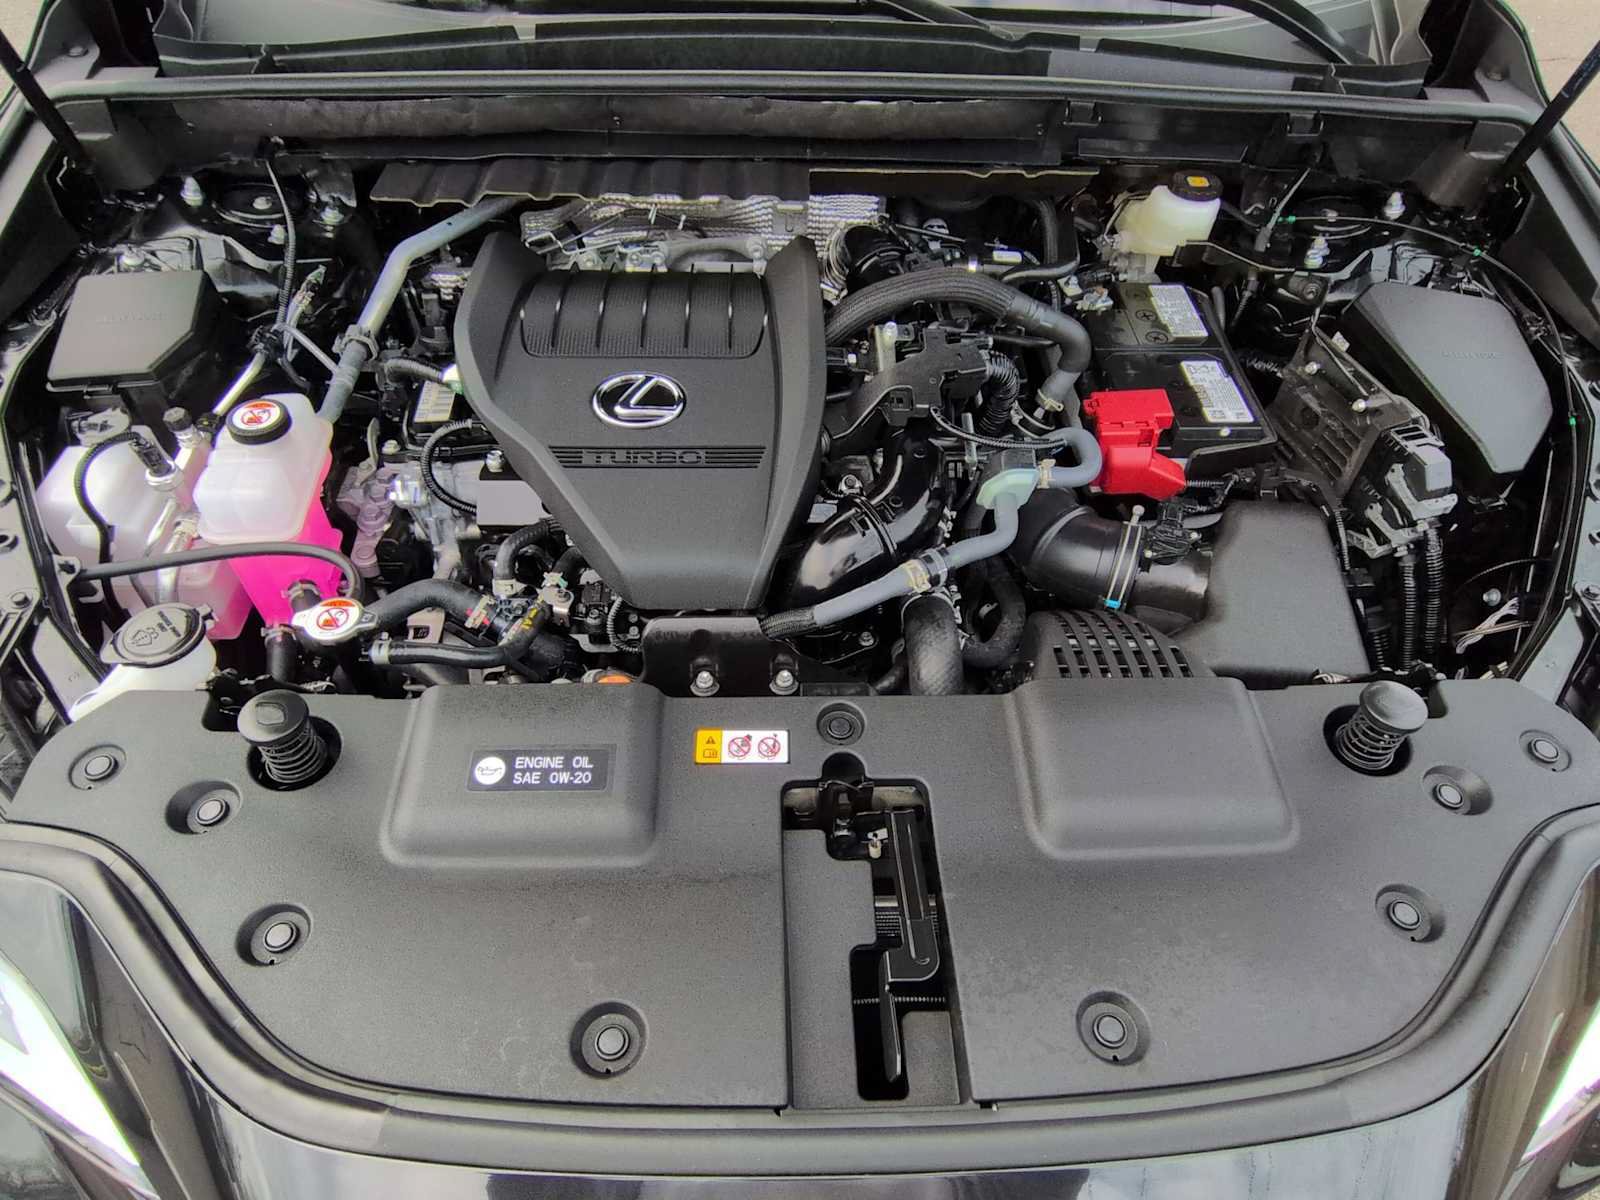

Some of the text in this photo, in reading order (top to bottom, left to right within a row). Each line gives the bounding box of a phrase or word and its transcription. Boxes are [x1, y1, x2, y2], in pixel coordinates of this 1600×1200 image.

[583, 450, 704, 465] TURBO
[514, 756, 594, 769] ENGINE OIL
[513, 772, 592, 784] SAE 0W-20
